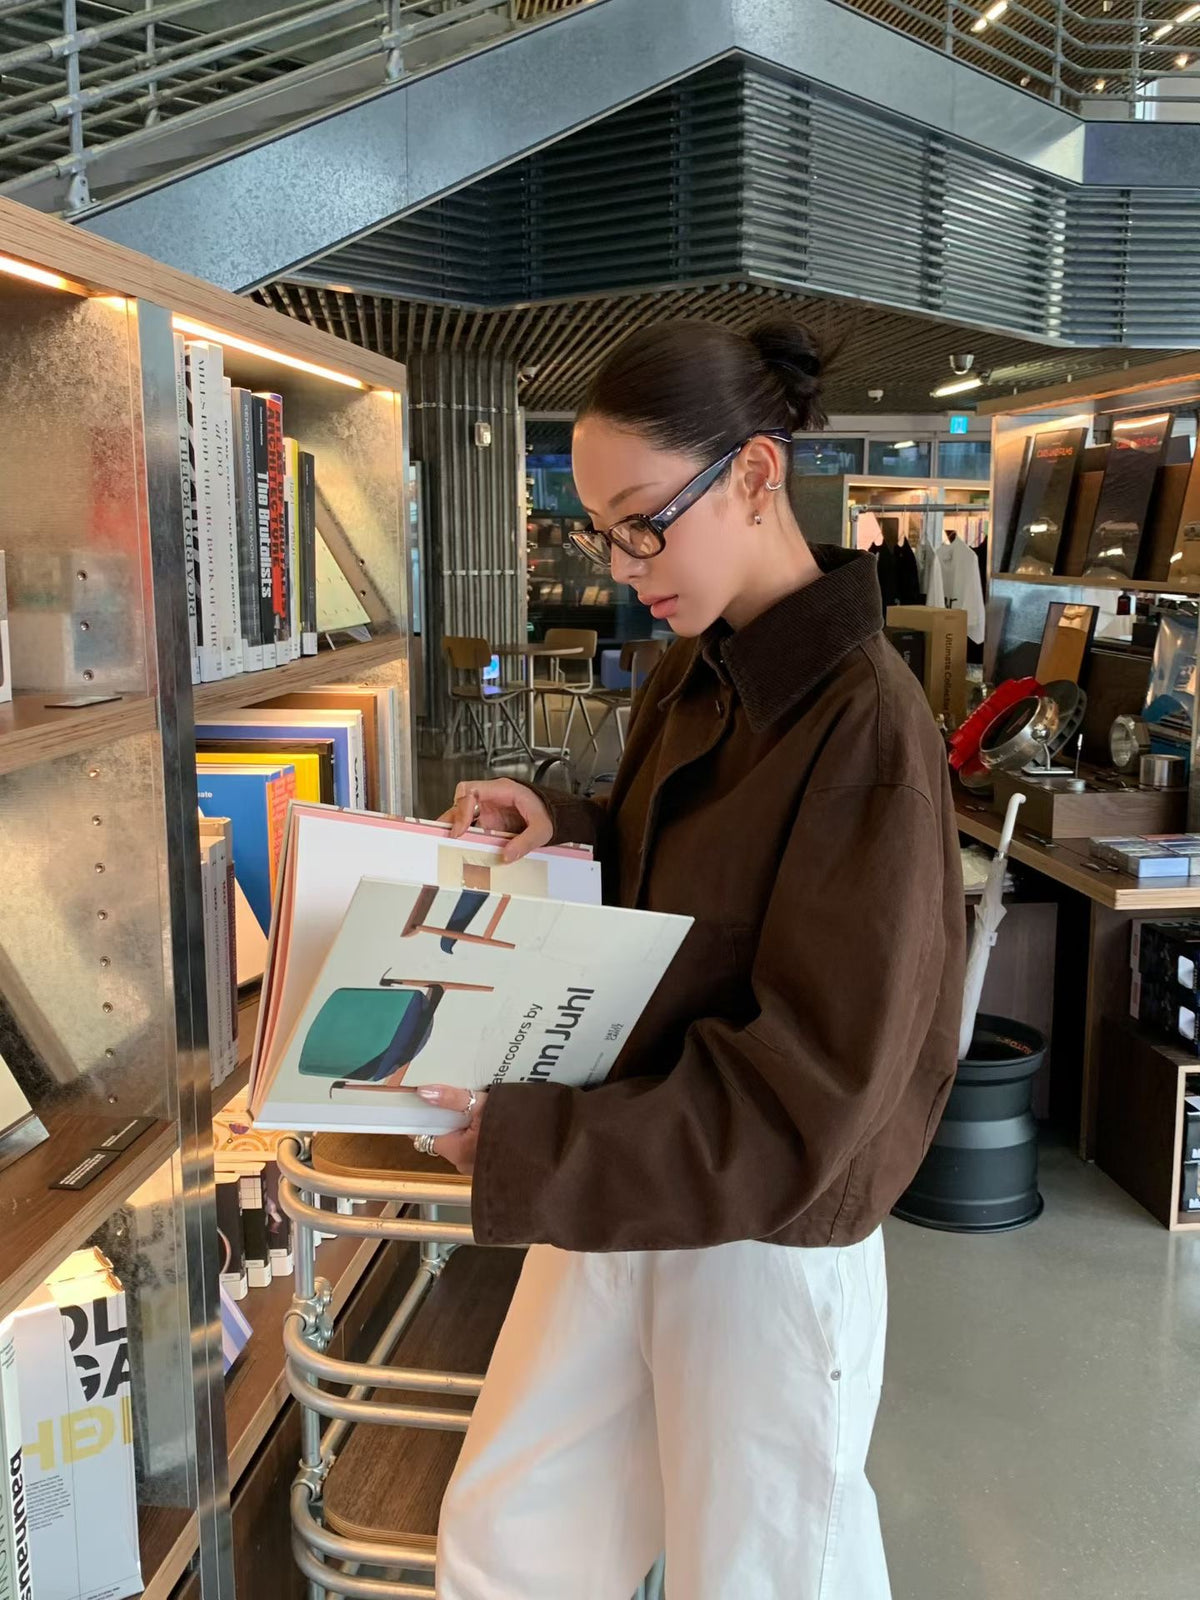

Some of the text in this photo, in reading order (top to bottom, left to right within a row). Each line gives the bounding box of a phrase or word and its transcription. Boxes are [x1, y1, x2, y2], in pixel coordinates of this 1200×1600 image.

[180, 427, 196, 617] RICARDO BOFILL
[257, 471, 272, 598] The Brutalists
[944, 633, 952, 671] Ultimate
[492, 1003, 543, 1085] atercolors by
[520, 1044, 564, 1083] inn
[545, 987, 595, 1041] Juhl
[10, 1447, 32, 1600] bauhaus
